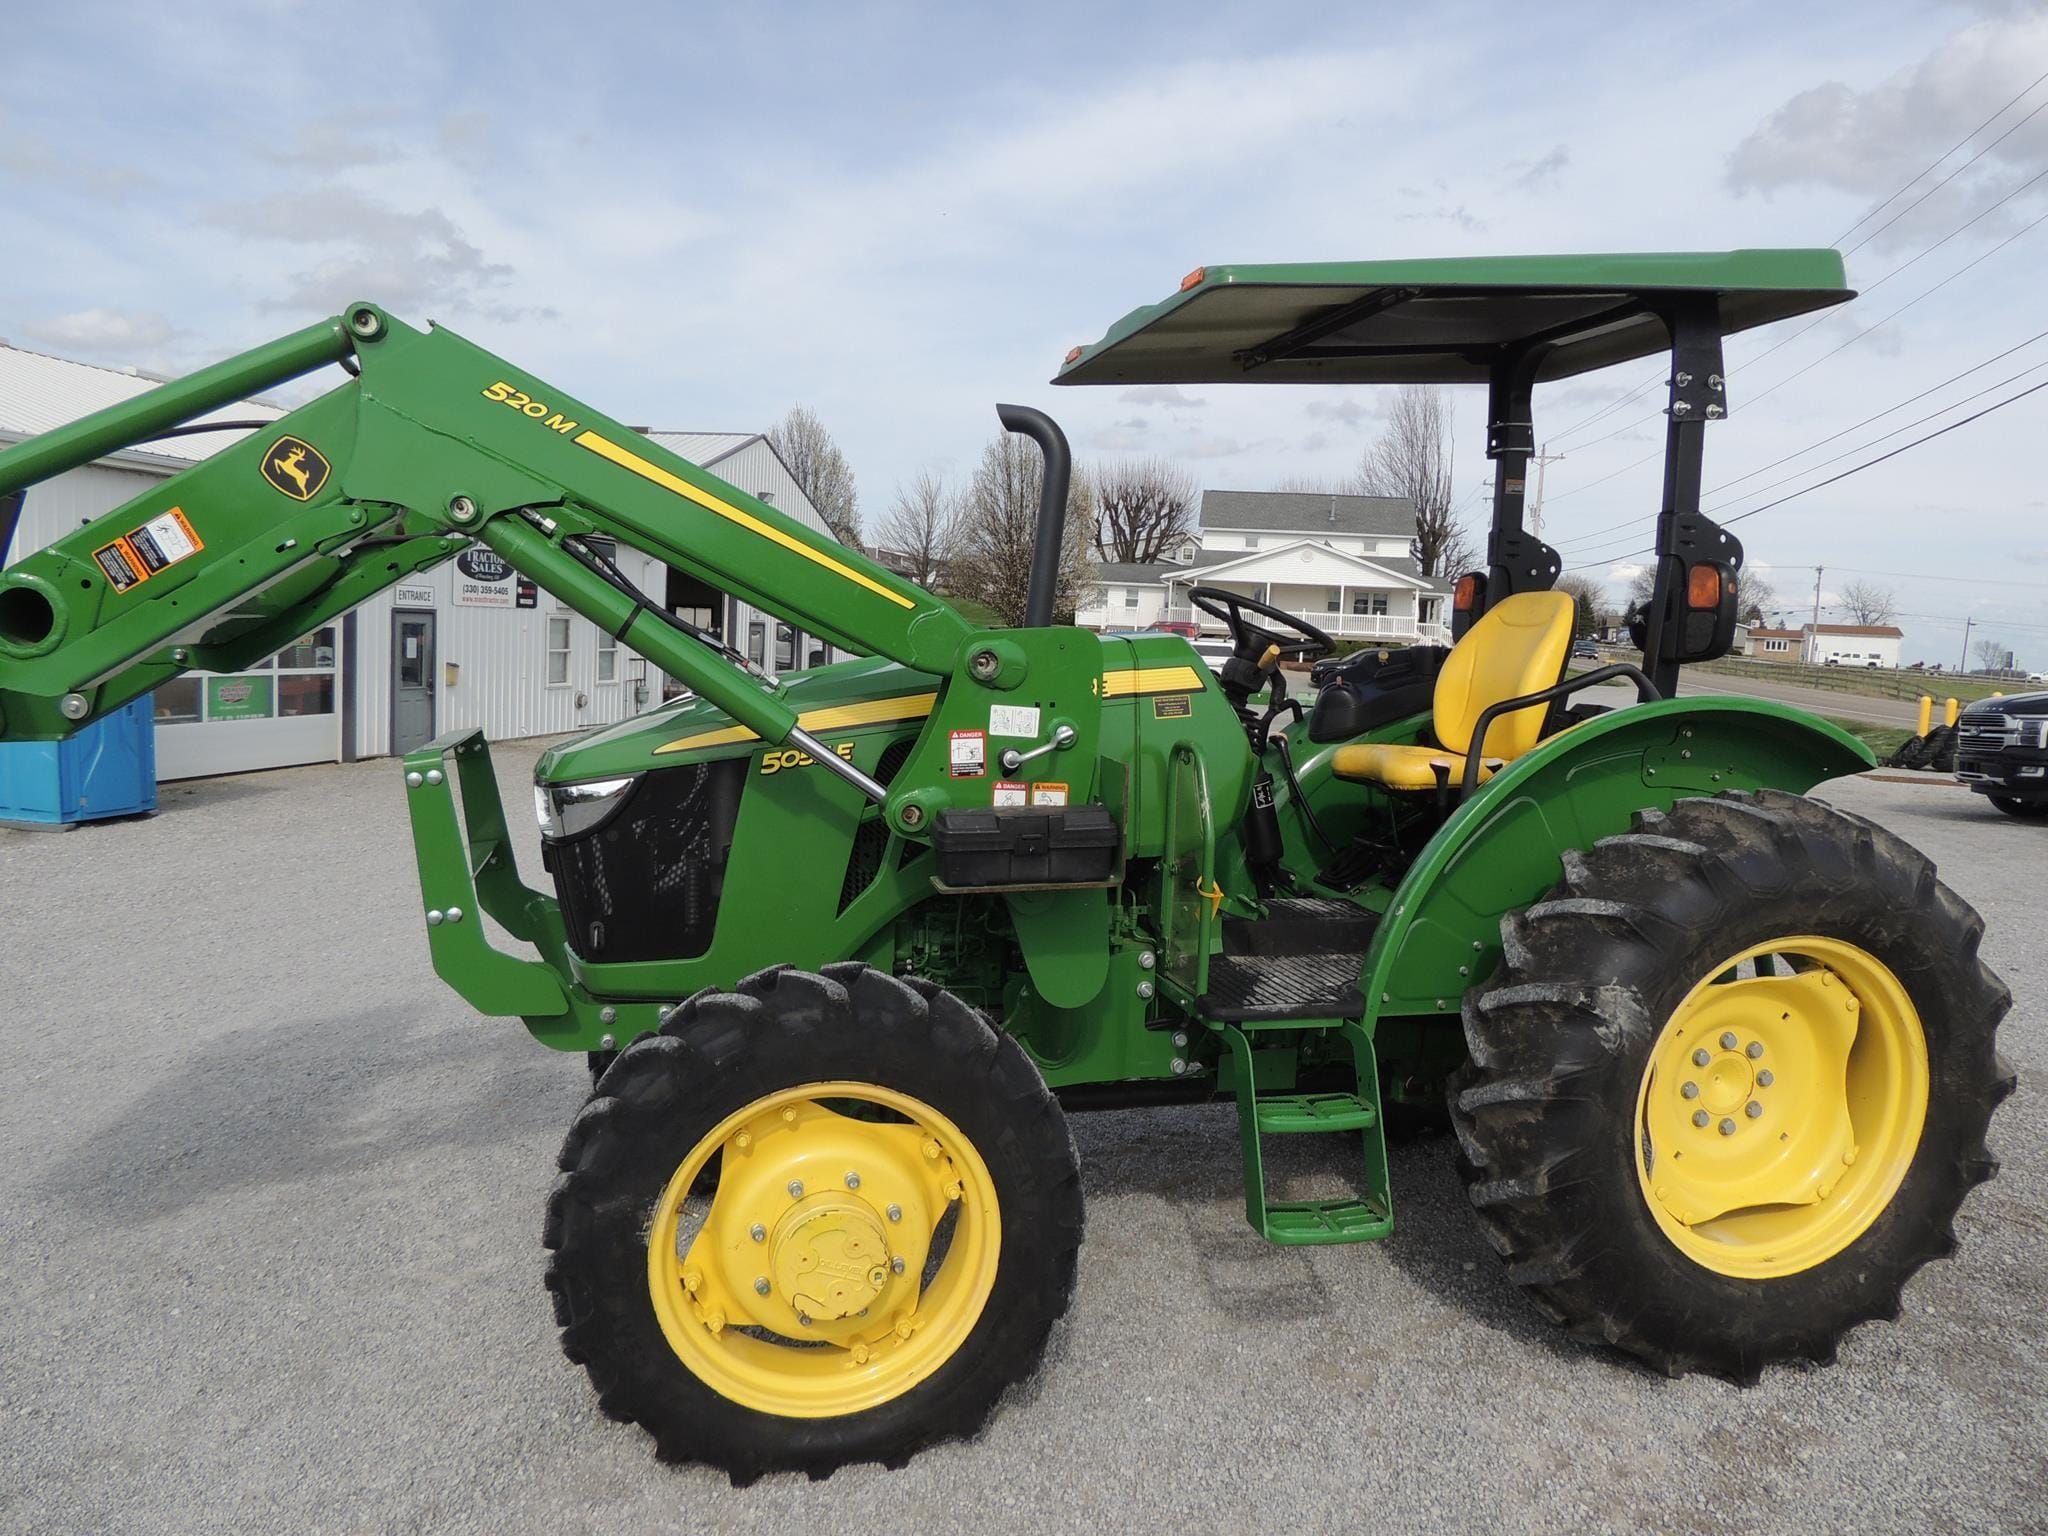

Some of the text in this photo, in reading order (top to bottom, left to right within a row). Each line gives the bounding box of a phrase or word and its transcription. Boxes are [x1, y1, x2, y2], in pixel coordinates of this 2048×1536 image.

[480, 381, 580, 435] 520 M
[471, 561, 503, 575] SALES
[398, 589, 432, 602] ENTRANCE
[463, 584, 479, 595] (330)
[959, 731, 983, 739] DANGER
[1003, 783, 1026, 791] DANGER
